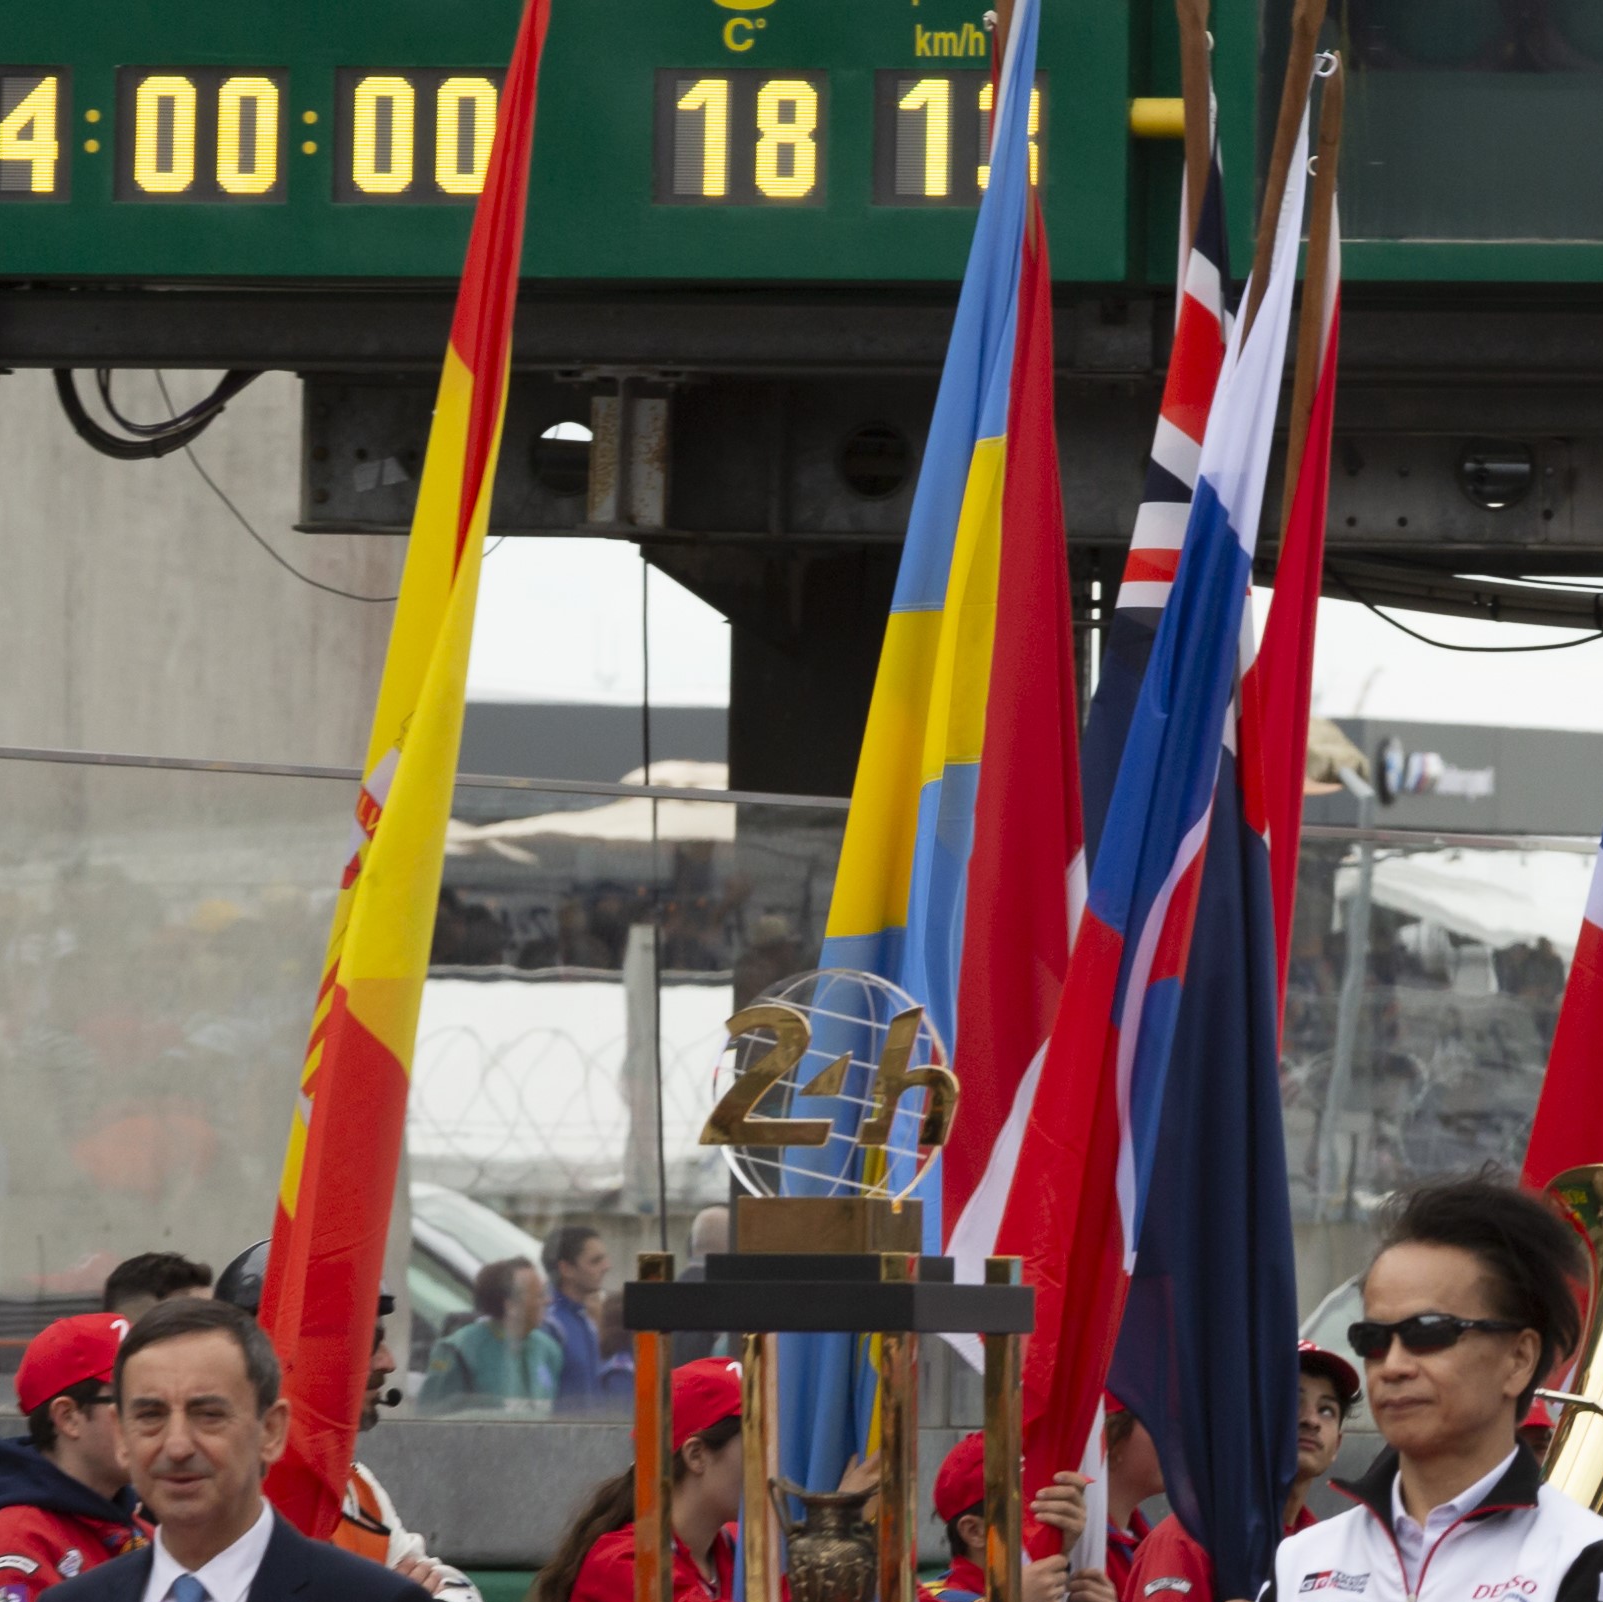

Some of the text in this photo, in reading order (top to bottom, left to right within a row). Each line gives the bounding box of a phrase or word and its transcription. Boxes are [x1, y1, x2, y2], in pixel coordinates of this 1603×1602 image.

[915, 23, 985, 57] km/h
[677, 79, 817, 197] 18
[698, 1003, 960, 1147] 24h
